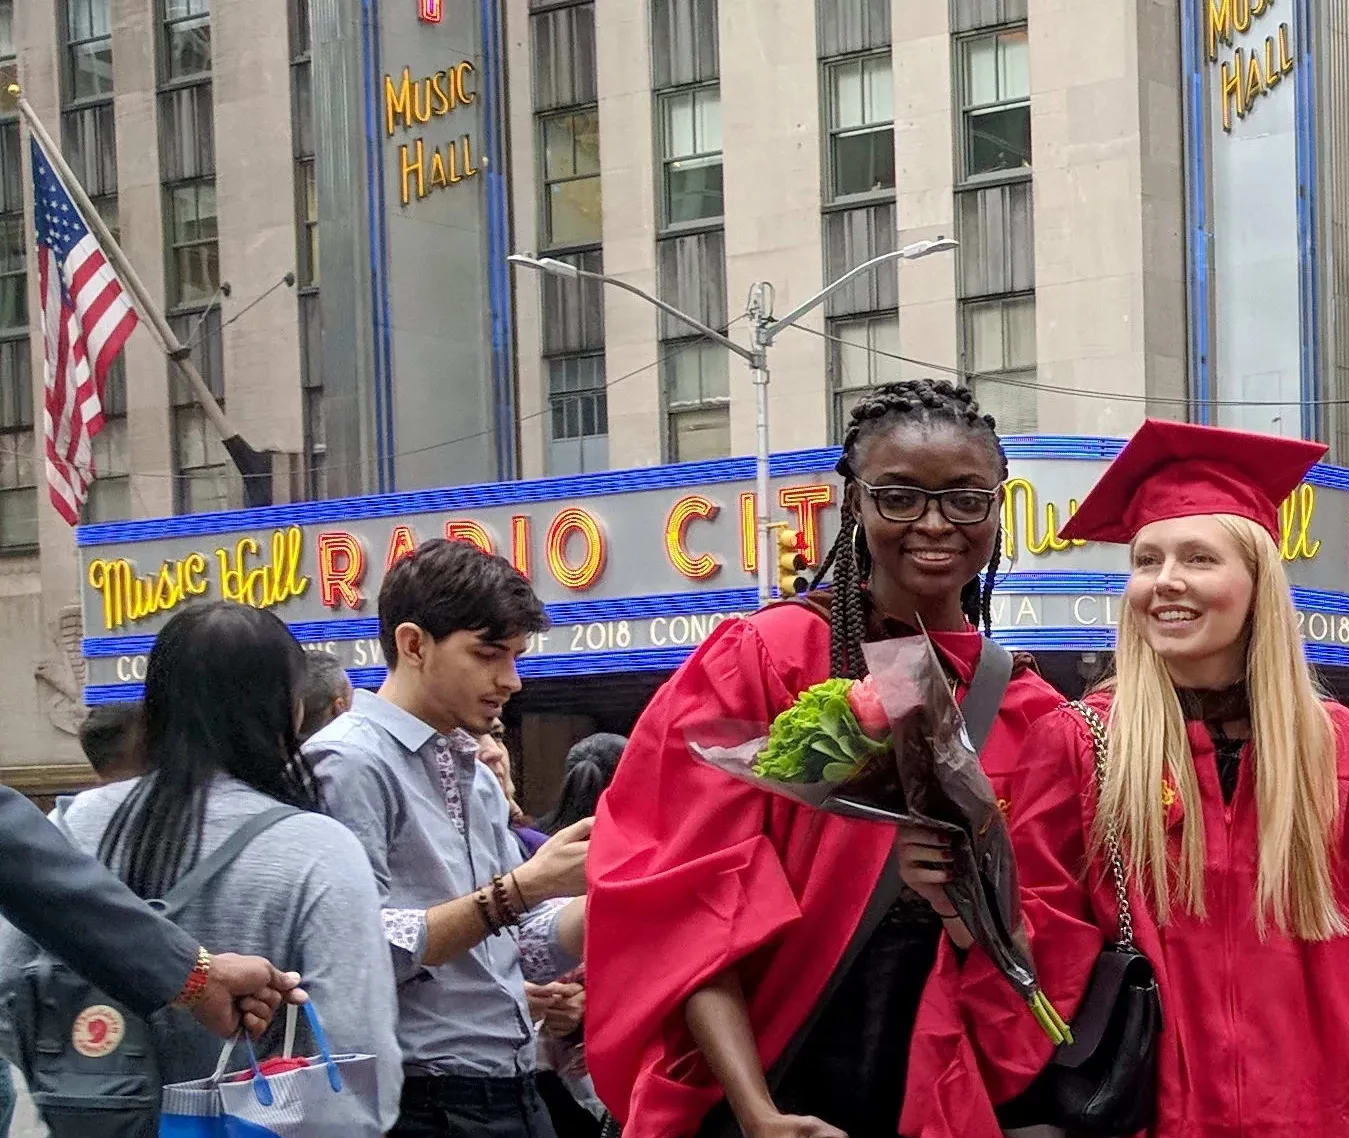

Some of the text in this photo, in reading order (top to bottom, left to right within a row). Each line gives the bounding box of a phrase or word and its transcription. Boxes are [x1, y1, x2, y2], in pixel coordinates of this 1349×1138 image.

[384, 60, 476, 136] MUSIC
[1221, 23, 1294, 133] HALL
[400, 133, 478, 205] HALL
[88, 552, 207, 630] Music
[215, 525, 311, 609] Hall
[665, 485, 835, 579] CIT
[354, 640, 384, 667] SV
[570, 619, 631, 651] 2018
